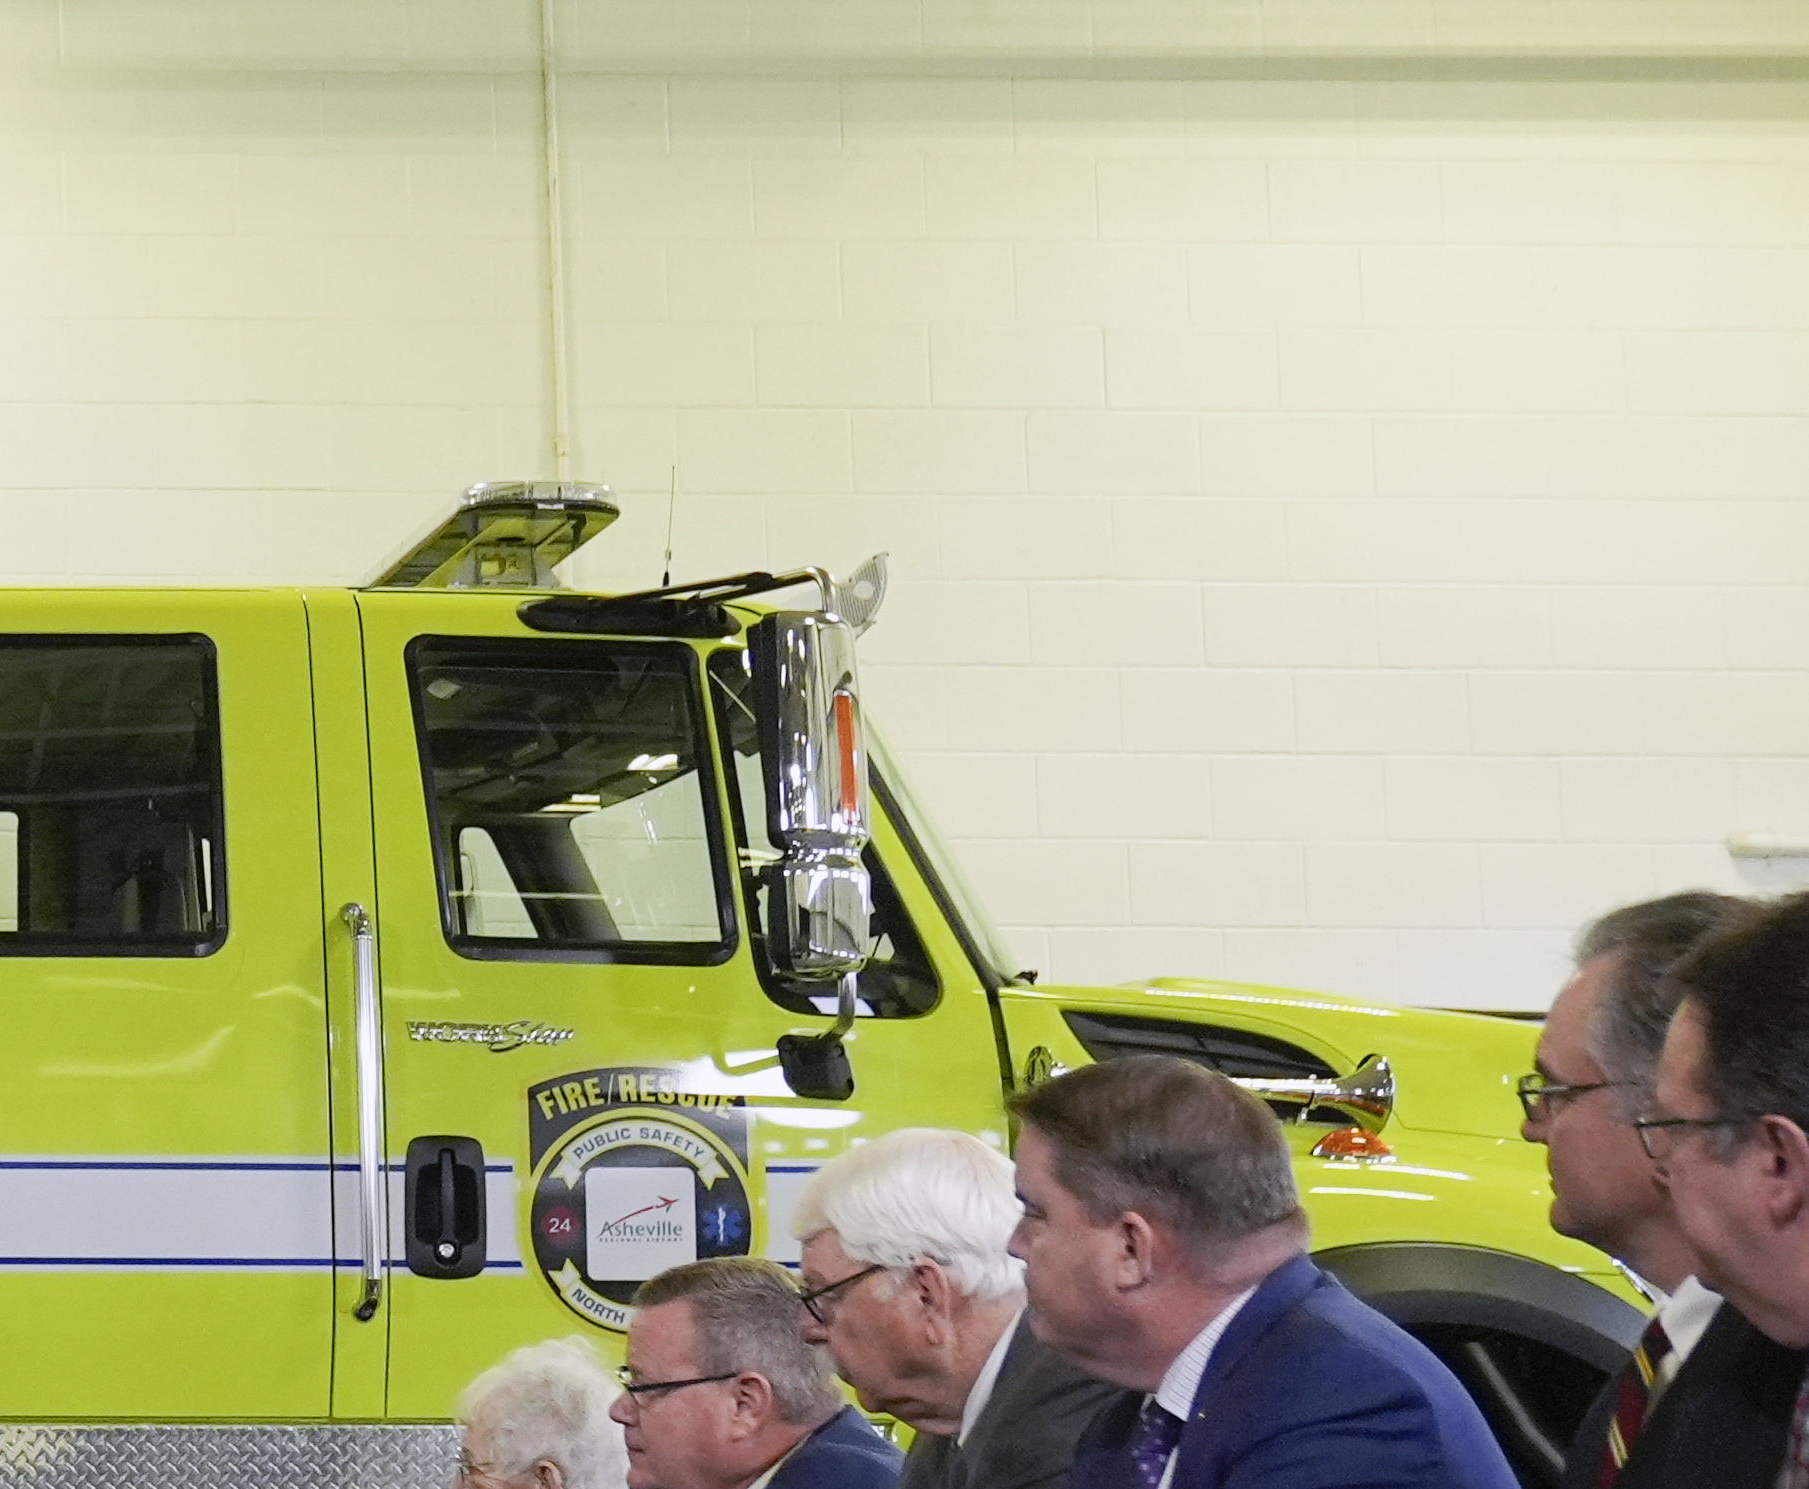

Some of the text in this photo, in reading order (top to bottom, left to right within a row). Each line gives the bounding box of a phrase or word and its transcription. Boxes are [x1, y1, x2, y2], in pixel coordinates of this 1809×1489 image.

[573, 1127, 705, 1159] PUBLIC SAFETY
[548, 1217, 572, 1234] 24
[596, 1221, 683, 1238] Asheville
[571, 1287, 626, 1324] NORTH
